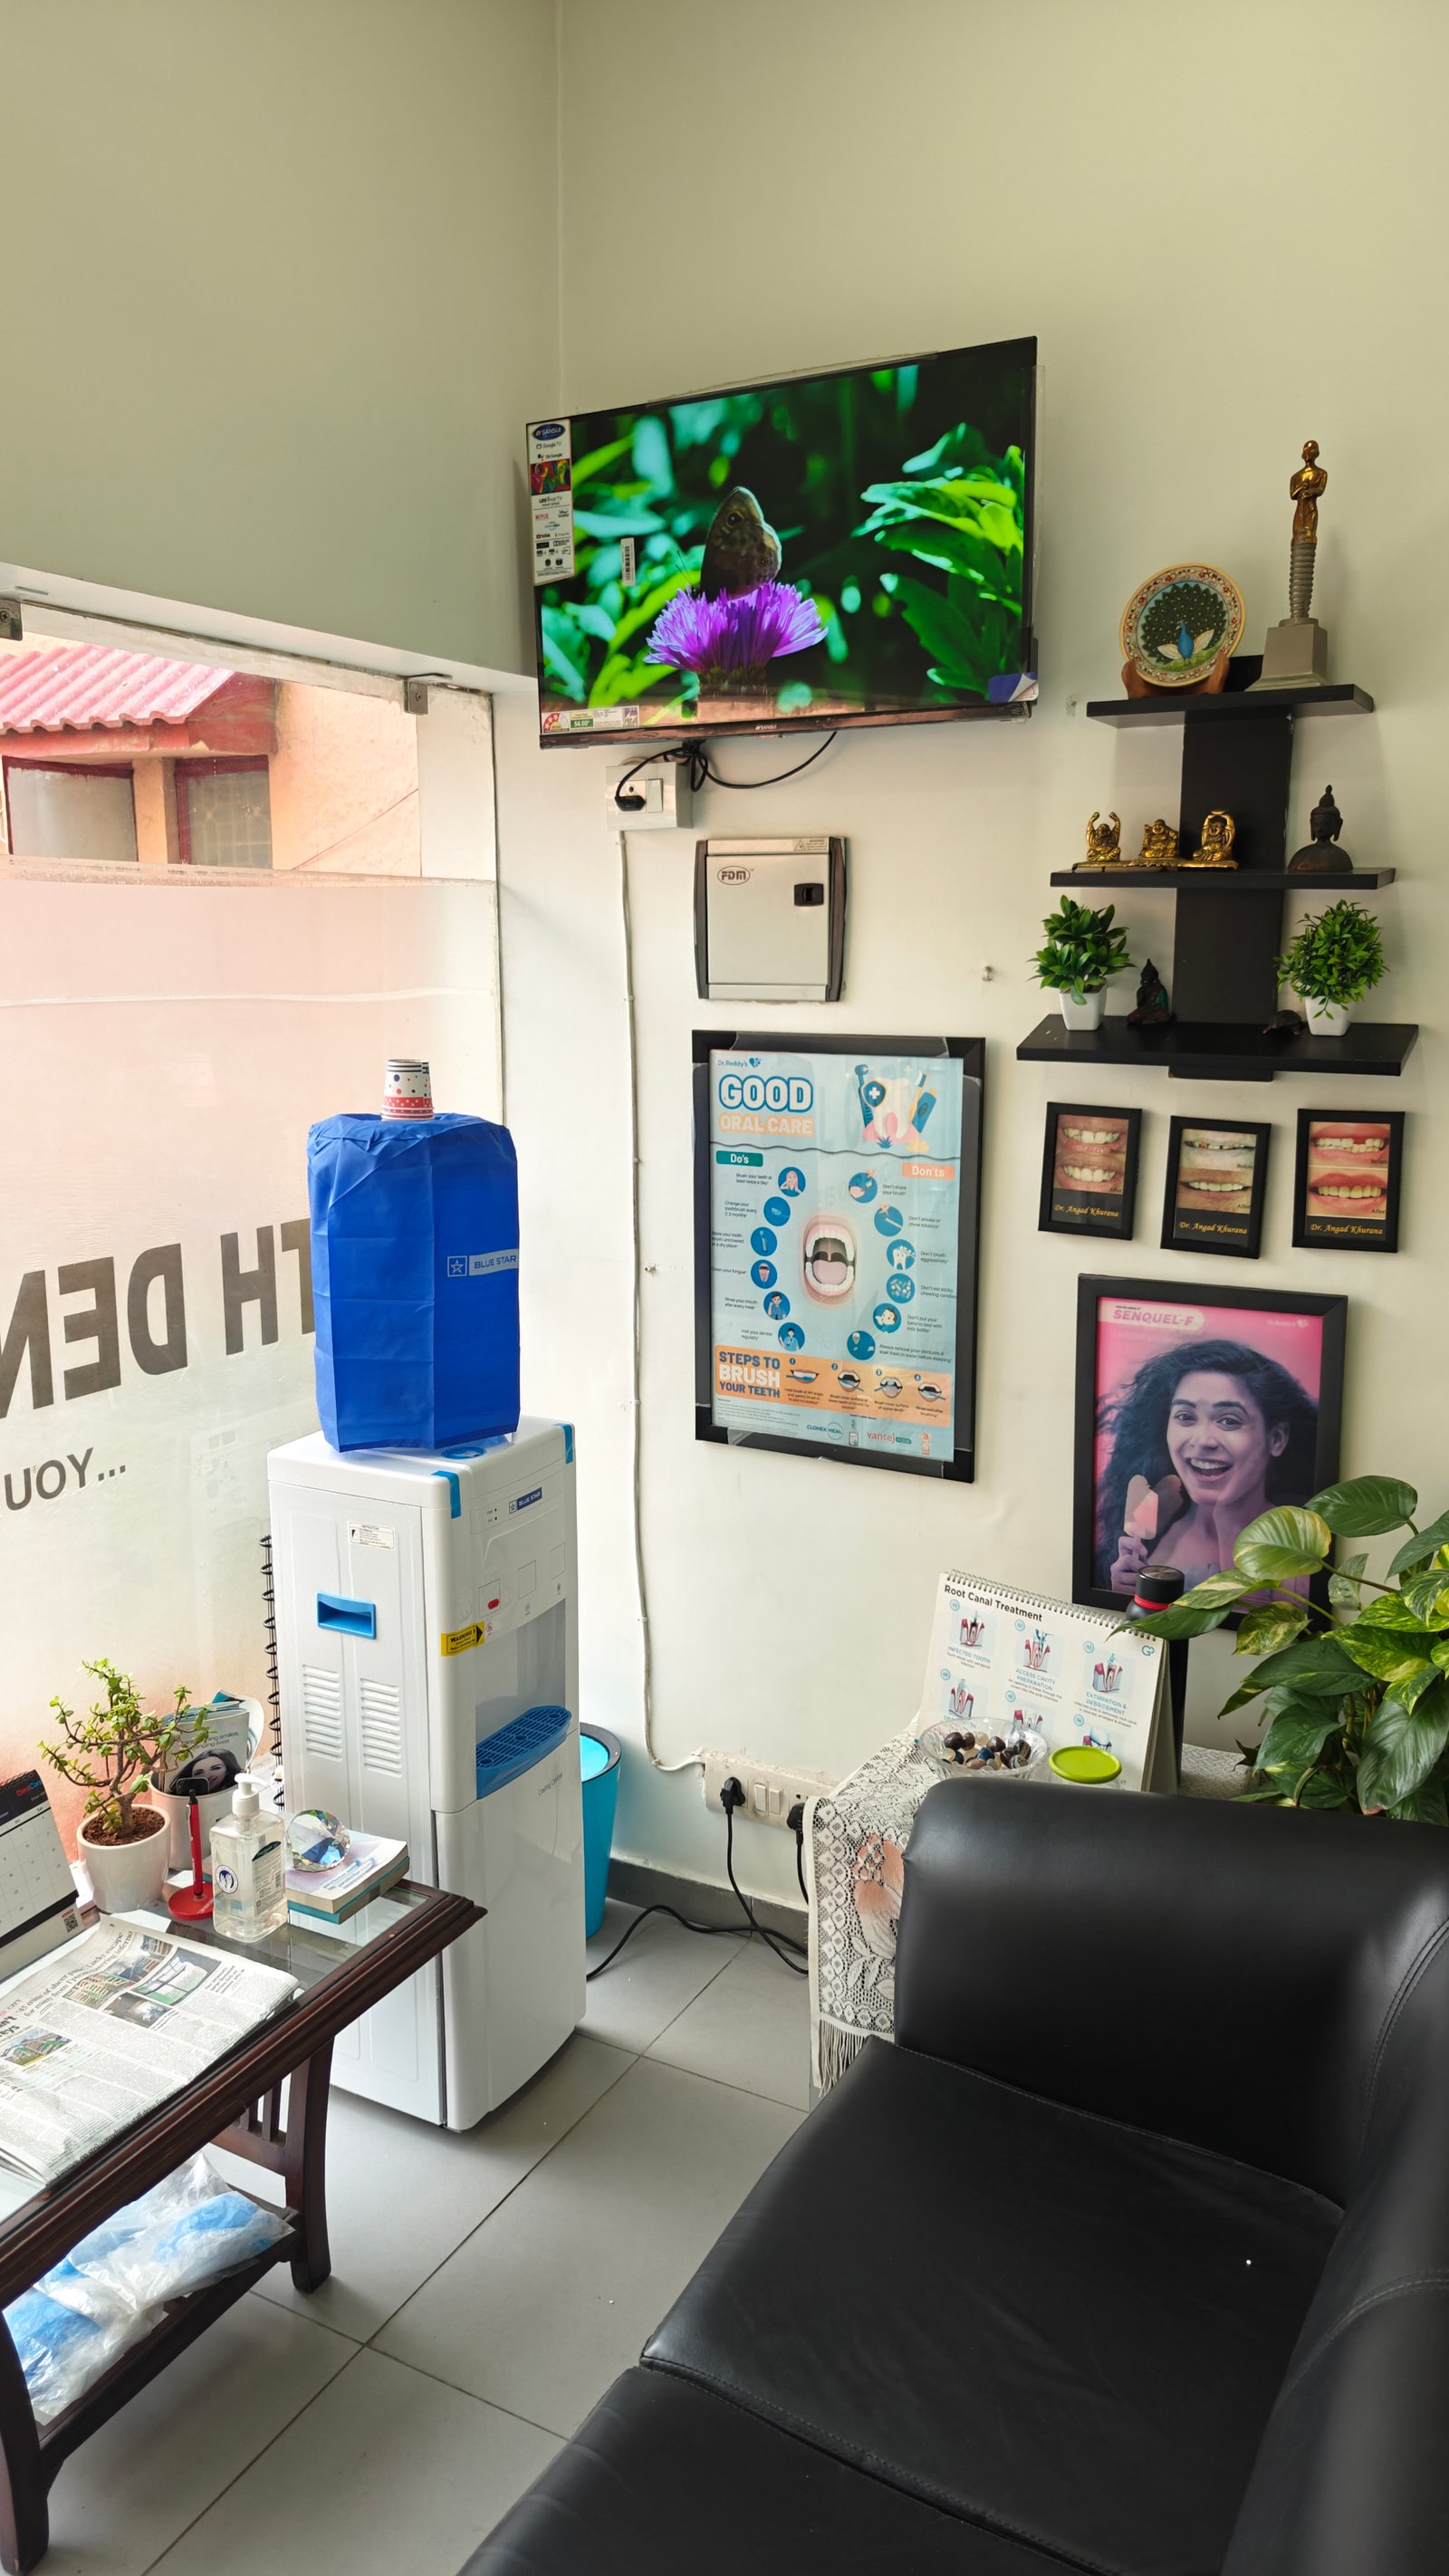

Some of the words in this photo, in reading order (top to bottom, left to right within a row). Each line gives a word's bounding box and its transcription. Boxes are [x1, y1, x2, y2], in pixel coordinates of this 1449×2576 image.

[542, 427, 561, 435] SANSUI
[721, 870, 746, 880] FDM
[718, 1073, 813, 1113] GOOD
[719, 1112, 765, 1134] ORAL
[765, 1115, 814, 1137] CARE
[730, 1153, 749, 1164] Do's
[912, 1165, 945, 1177] Don'ts
[1066, 1205, 1089, 1216] Angad
[1089, 1206, 1119, 1217] Khurana
[1179, 1221, 1191, 1229] Dr.
[1191, 1223, 1217, 1233] Angad
[1217, 1224, 1247, 1235] Khurana
[1310, 1223, 1322, 1231] Dr.
[1324, 1224, 1349, 1235] Angad
[1349, 1225, 1383, 1235] Khurana
[474, 1258, 494, 1269] BLUE
[496, 1254, 516, 1265] STAR
[1113, 1309, 1195, 1326] SENQUEL-F
[718, 1350, 760, 1368] STEPS
[763, 1356, 781, 1370] TO
[718, 1363, 781, 1389] BRUSH
[719, 1381, 745, 1393] YOUR
[748, 1385, 781, 1399] TEETH
[867, 1431, 895, 1444] vantej
[518, 1496, 530, 1506] BLUE
[530, 1491, 541, 1501] STAR
[944, 1584, 965, 1599] Root
[967, 1591, 993, 1607] Canal
[994, 1600, 1043, 1622] Treatment
[450, 1629, 472, 1643] WARNING
[947, 1645, 973, 1658] INFECTED
[973, 1653, 991, 1664] TOOTH
[1015, 1668, 1036, 1679] ACCESS
[1037, 1674, 1056, 1685] CAVITY
[1016, 1674, 1053, 1691] PREPARATION
[1086, 1691, 1122, 1708] EXTIRPATION
[51, 1975, 68, 1989] sheer
[106, 1932, 123, 1954] escape
[24, 2008, 34, 2017] for
[35, 1996, 53, 2009] many
[52, 1985, 69, 1997] from
[115, 1930, 133, 1955] inferno
